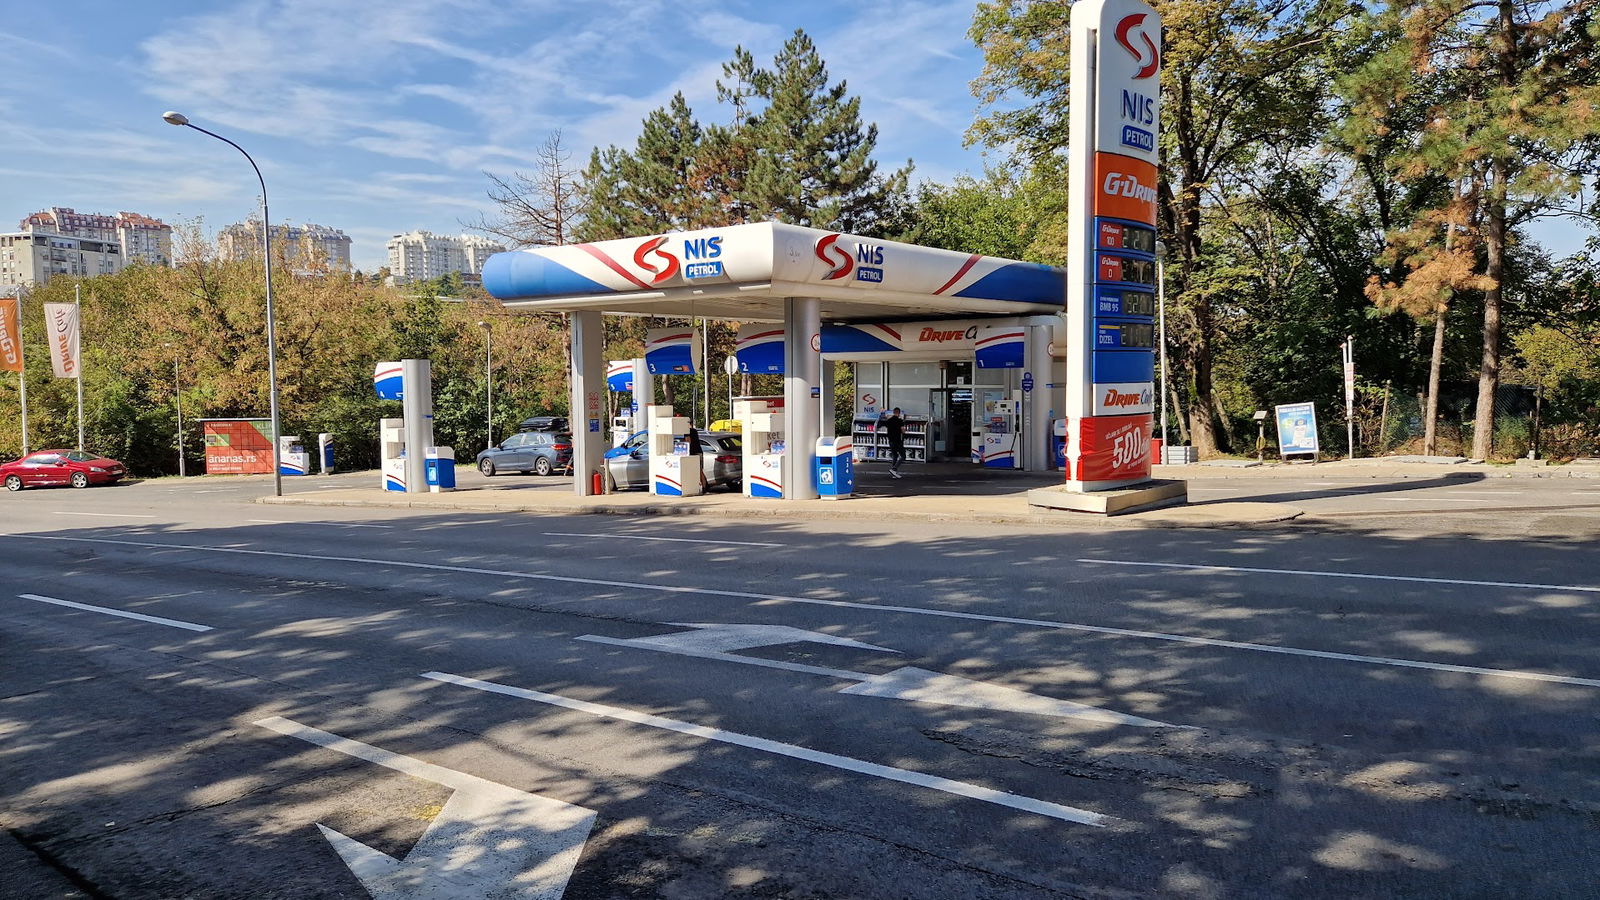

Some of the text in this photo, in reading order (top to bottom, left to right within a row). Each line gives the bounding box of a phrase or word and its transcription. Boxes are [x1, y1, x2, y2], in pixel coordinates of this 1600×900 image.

[1122, 89, 1153, 125] NIS
[1126, 128, 1153, 149] PETROL
[684, 236, 722, 260] NIS
[857, 243, 884, 265] NIS
[688, 265, 718, 275] PETROL
[859, 269, 881, 280] PETROL
[1099, 302, 1119, 312] BMB 95
[919, 327, 965, 343] DRIVE
[1099, 334, 1114, 344] DIZEL
[649, 363, 656, 372] 3
[741, 362, 749, 372] 2
[1103, 388, 1140, 409] DRIVE
[1112, 426, 1142, 469] 500
